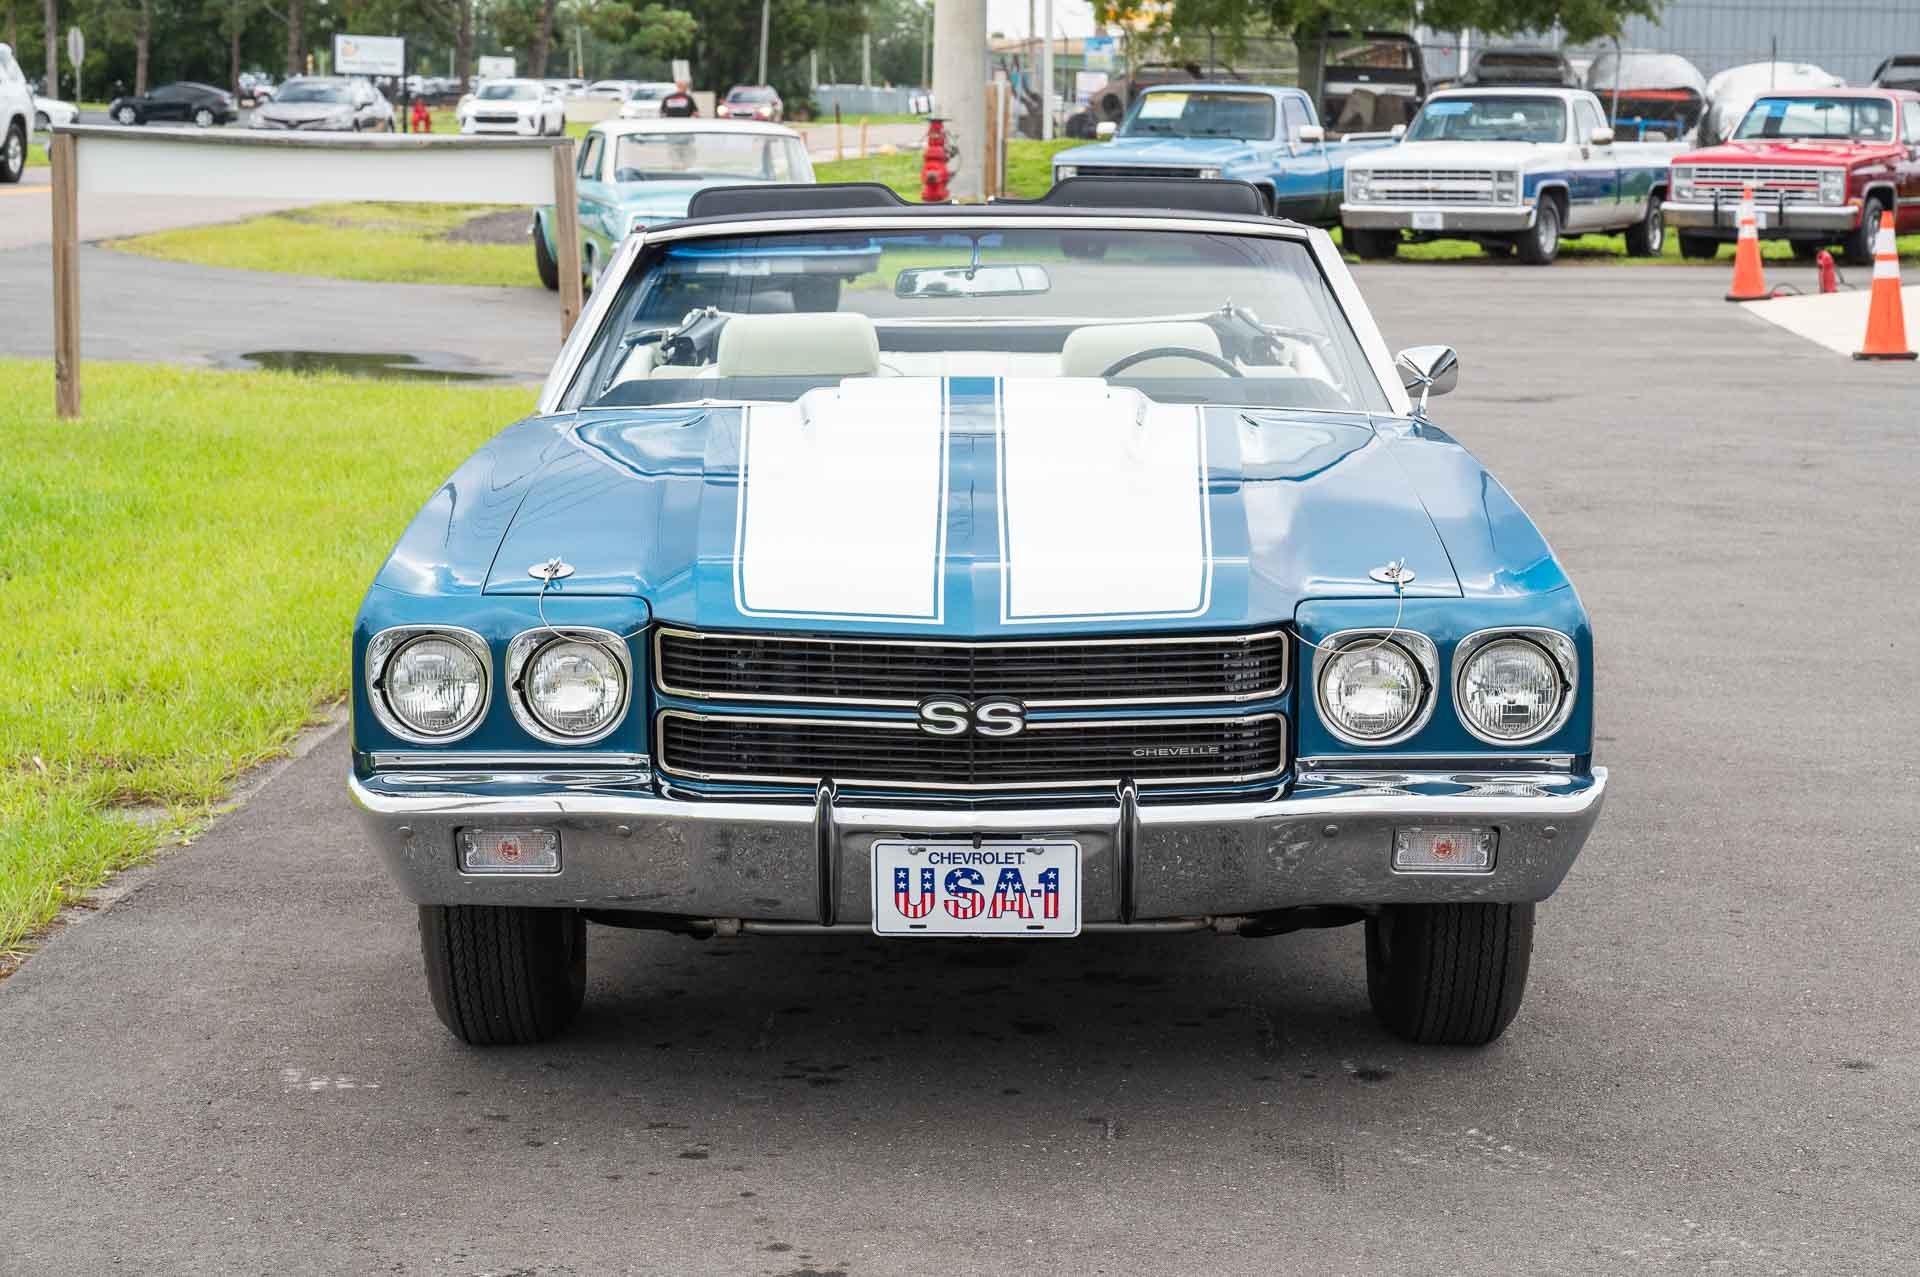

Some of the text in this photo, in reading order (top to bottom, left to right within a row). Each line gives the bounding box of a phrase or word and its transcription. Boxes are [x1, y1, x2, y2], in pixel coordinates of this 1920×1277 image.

[920, 701, 1024, 737] SS
[1132, 746, 1220, 757] CHEVELLE
[894, 867, 1060, 919] USA-1
